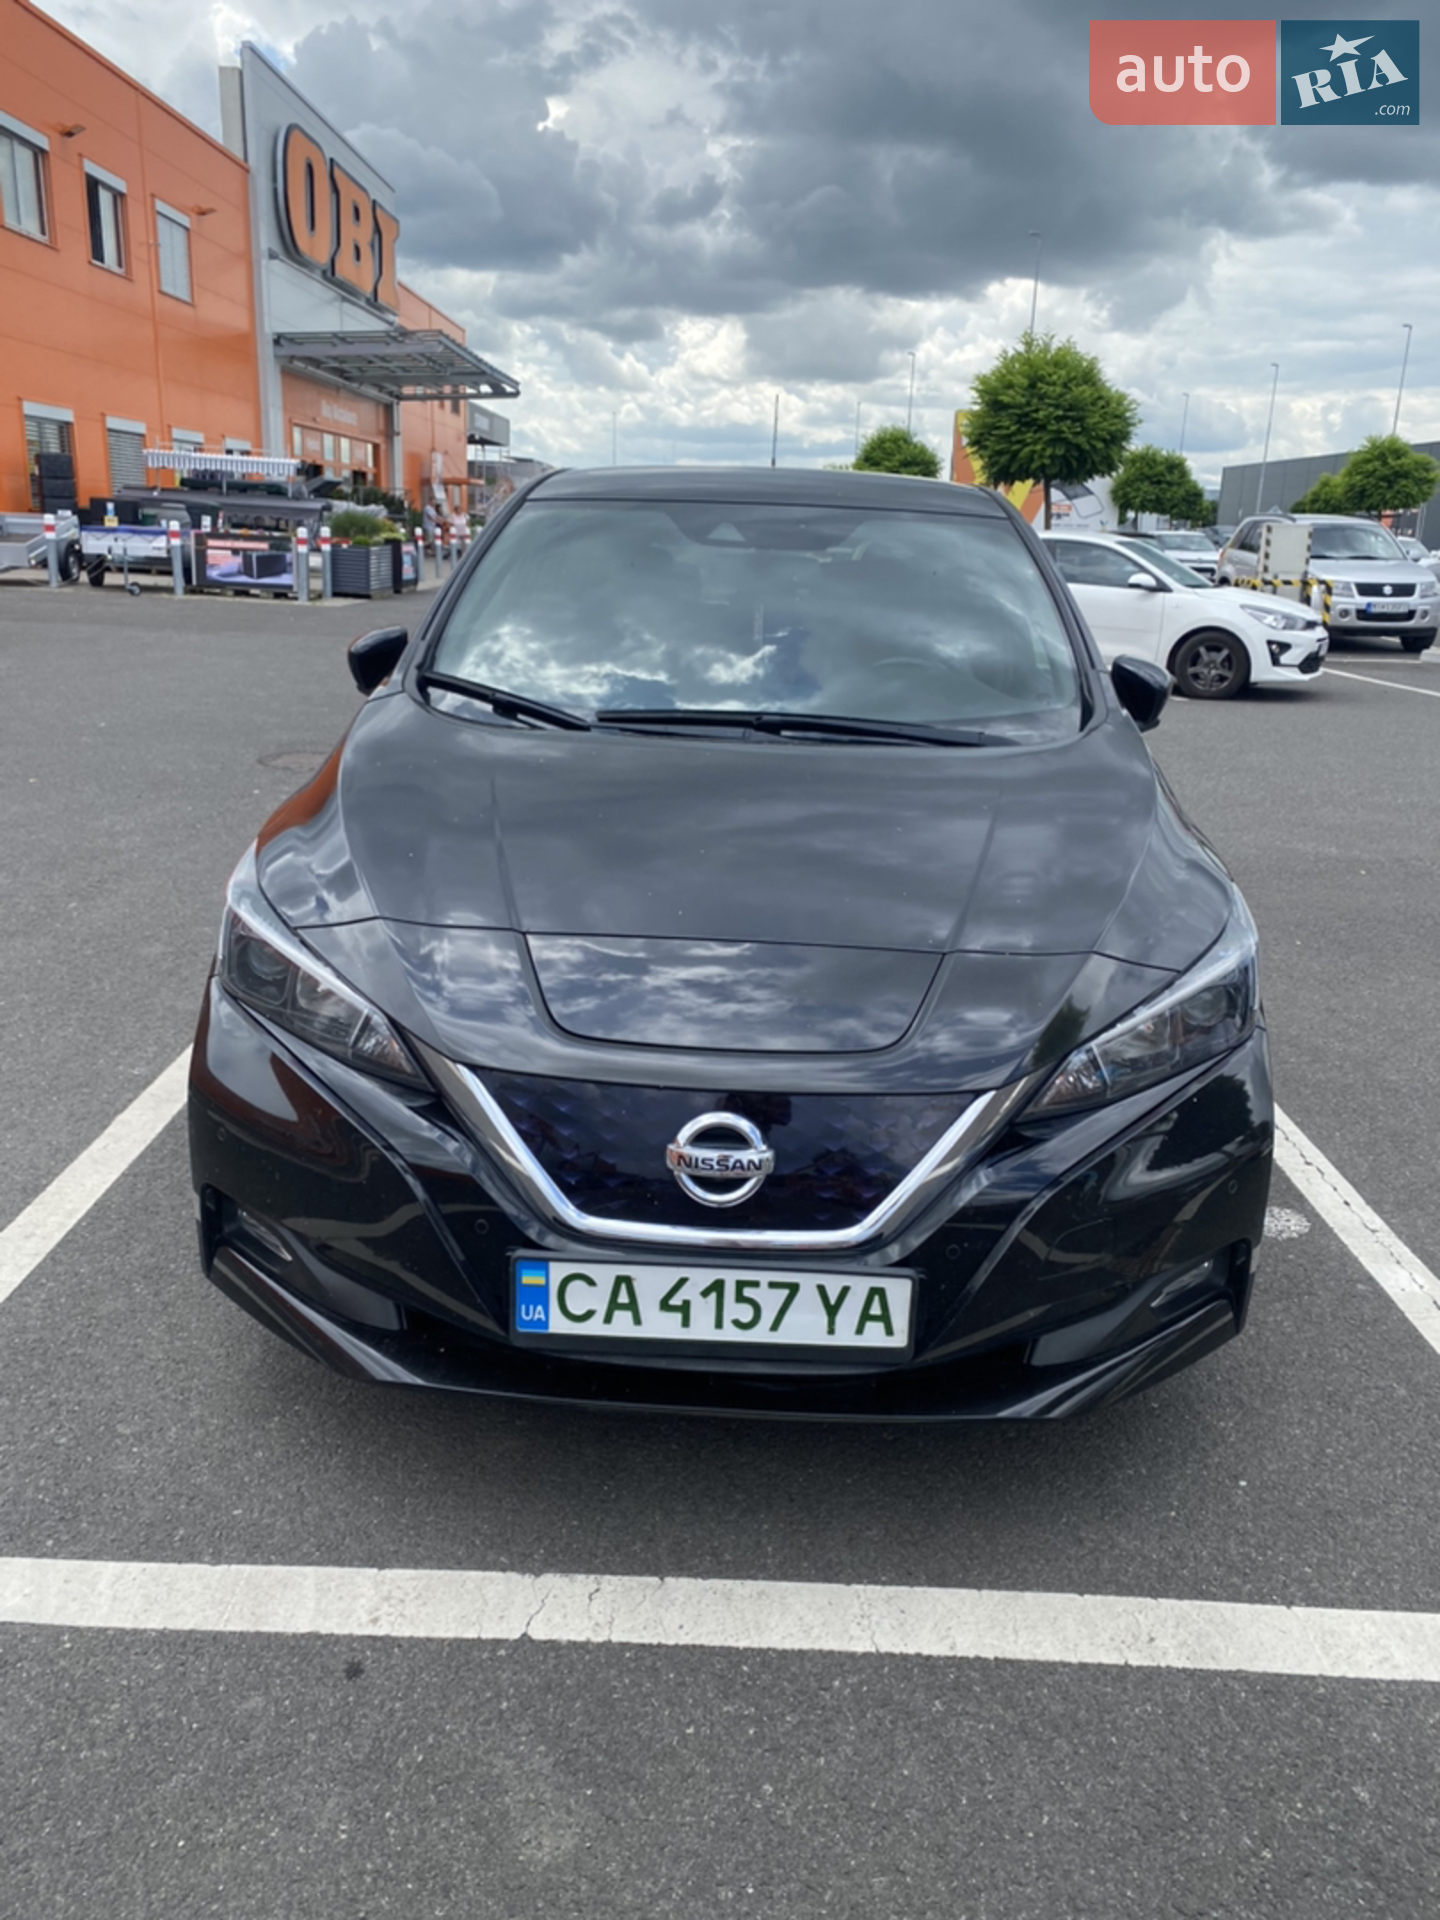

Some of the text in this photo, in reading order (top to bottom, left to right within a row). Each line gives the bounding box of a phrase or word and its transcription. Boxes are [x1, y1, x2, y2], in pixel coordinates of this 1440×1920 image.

[277, 124, 399, 315] OBI
[676, 1155, 763, 1172] NISSAN
[521, 1304, 546, 1321] UA
[556, 1272, 894, 1336] CA 4157 YA
